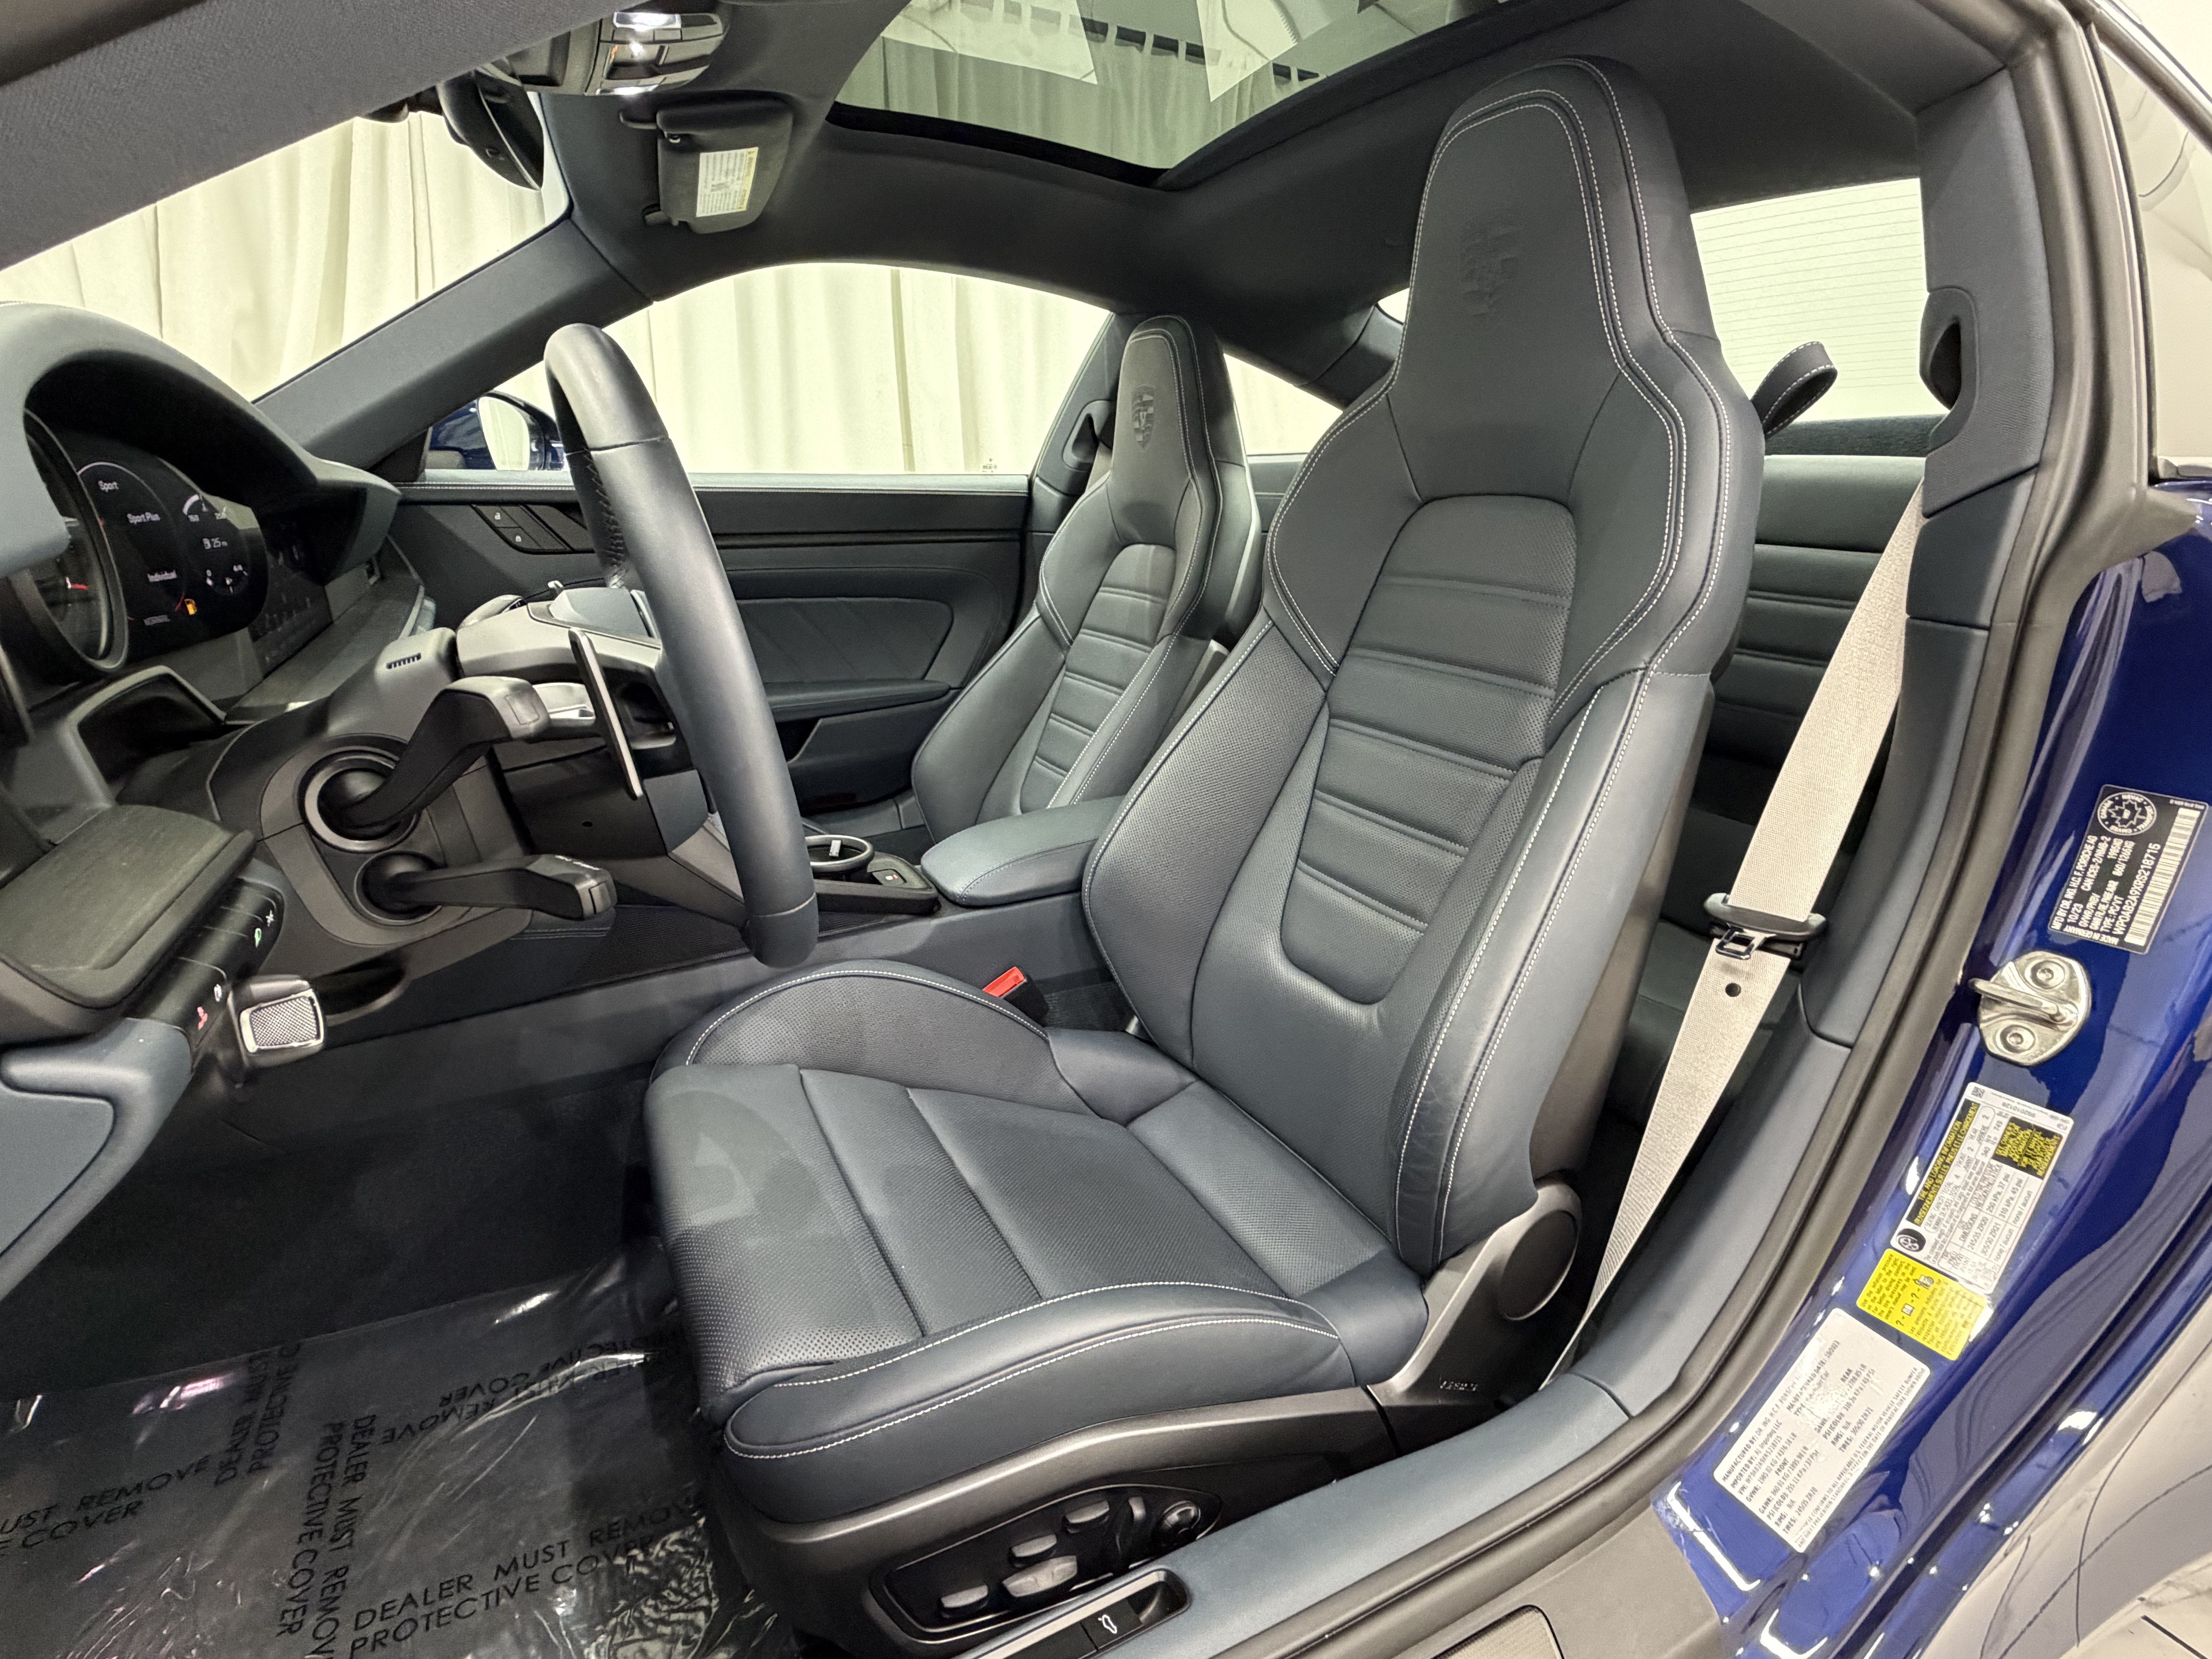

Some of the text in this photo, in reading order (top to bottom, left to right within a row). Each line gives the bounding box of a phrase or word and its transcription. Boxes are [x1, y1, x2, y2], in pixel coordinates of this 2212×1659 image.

[98, 480, 119, 493] Sport
[127, 513, 146, 524] Sport
[2075, 843, 2095, 871] PORSCHE
[2080, 876, 2095, 892] CAN
[2056, 907, 2069, 917] BY
[2066, 902, 2084, 924] 10/23
[2051, 916, 2065, 930] MFD
[2091, 932, 2101, 941] IN
[1996, 1180, 2006, 1190] 37
[1997, 1206, 2009, 1219] 310
[1839, 1367, 1854, 1383] REAR
[439, 1372, 531, 1408] COVER
[1769, 1457, 1779, 1468] KG
[1774, 1457, 1790, 1477] FRONT
[329, 1414, 376, 1552] DEALER MUST
[1780, 1471, 1790, 1482] KG
[0, 1454, 211, 1535] UST REMOVE
[22, 1499, 144, 1548] COVER
[275, 1422, 346, 1638] PROTECTIVE COVER
[354, 1539, 570, 1632] DEALER MUST
[349, 1573, 540, 1659] PROTECTIVE
